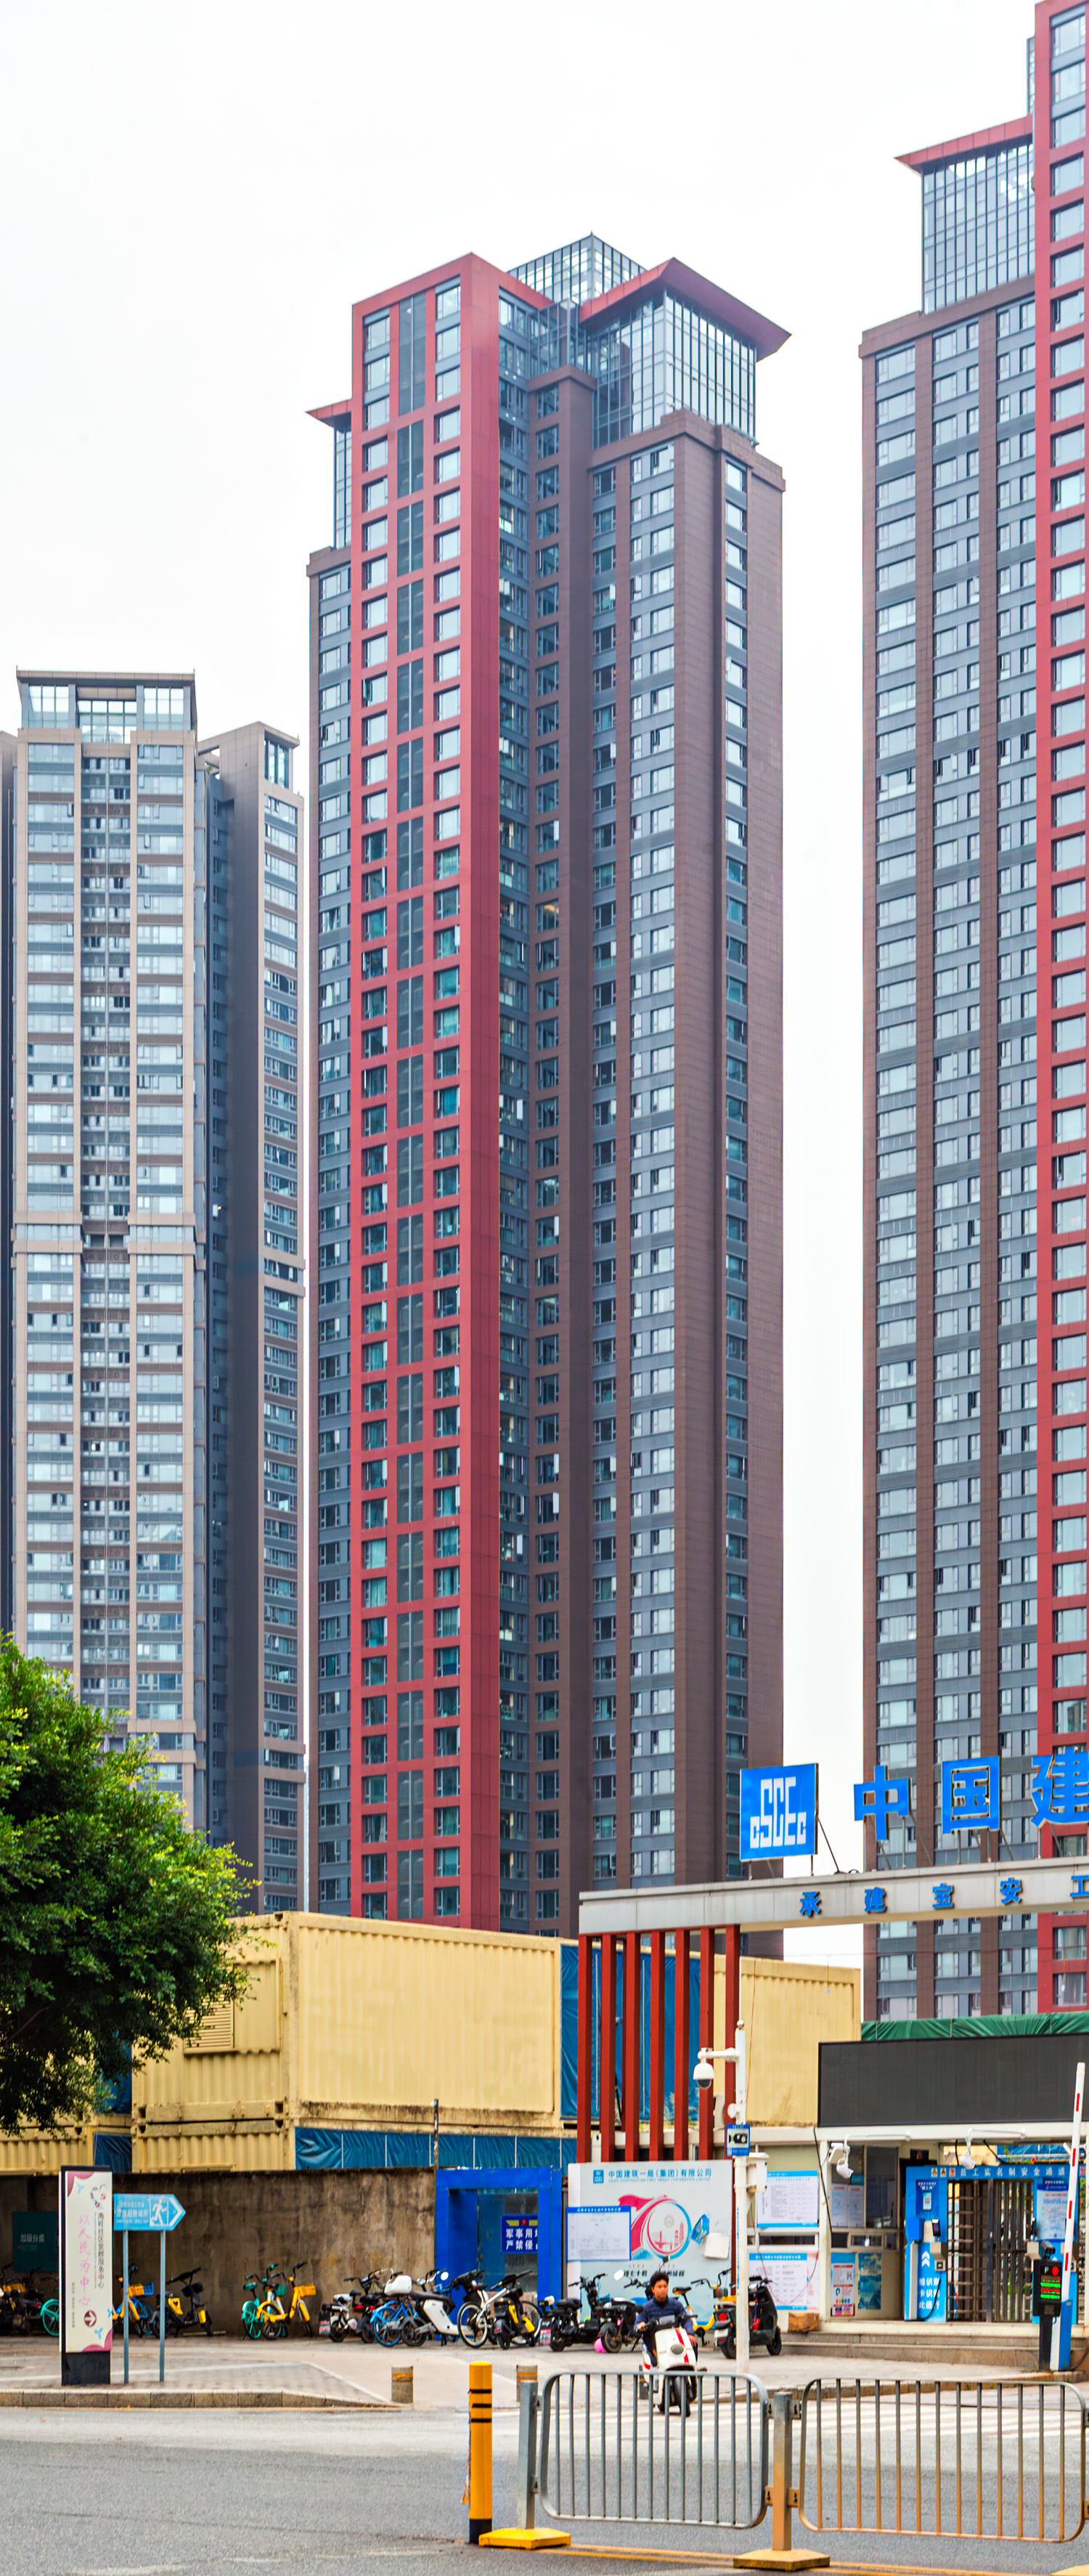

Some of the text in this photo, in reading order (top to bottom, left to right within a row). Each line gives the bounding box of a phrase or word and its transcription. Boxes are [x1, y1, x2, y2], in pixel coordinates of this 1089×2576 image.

[854, 1747, 1089, 1841] 中国建
[799, 1874, 1089, 1917] 承建宝安工
[960, 2166, 1065, 2177] 员工实名制安全通道
[78, 2213, 91, 2307] 以人民为中心
